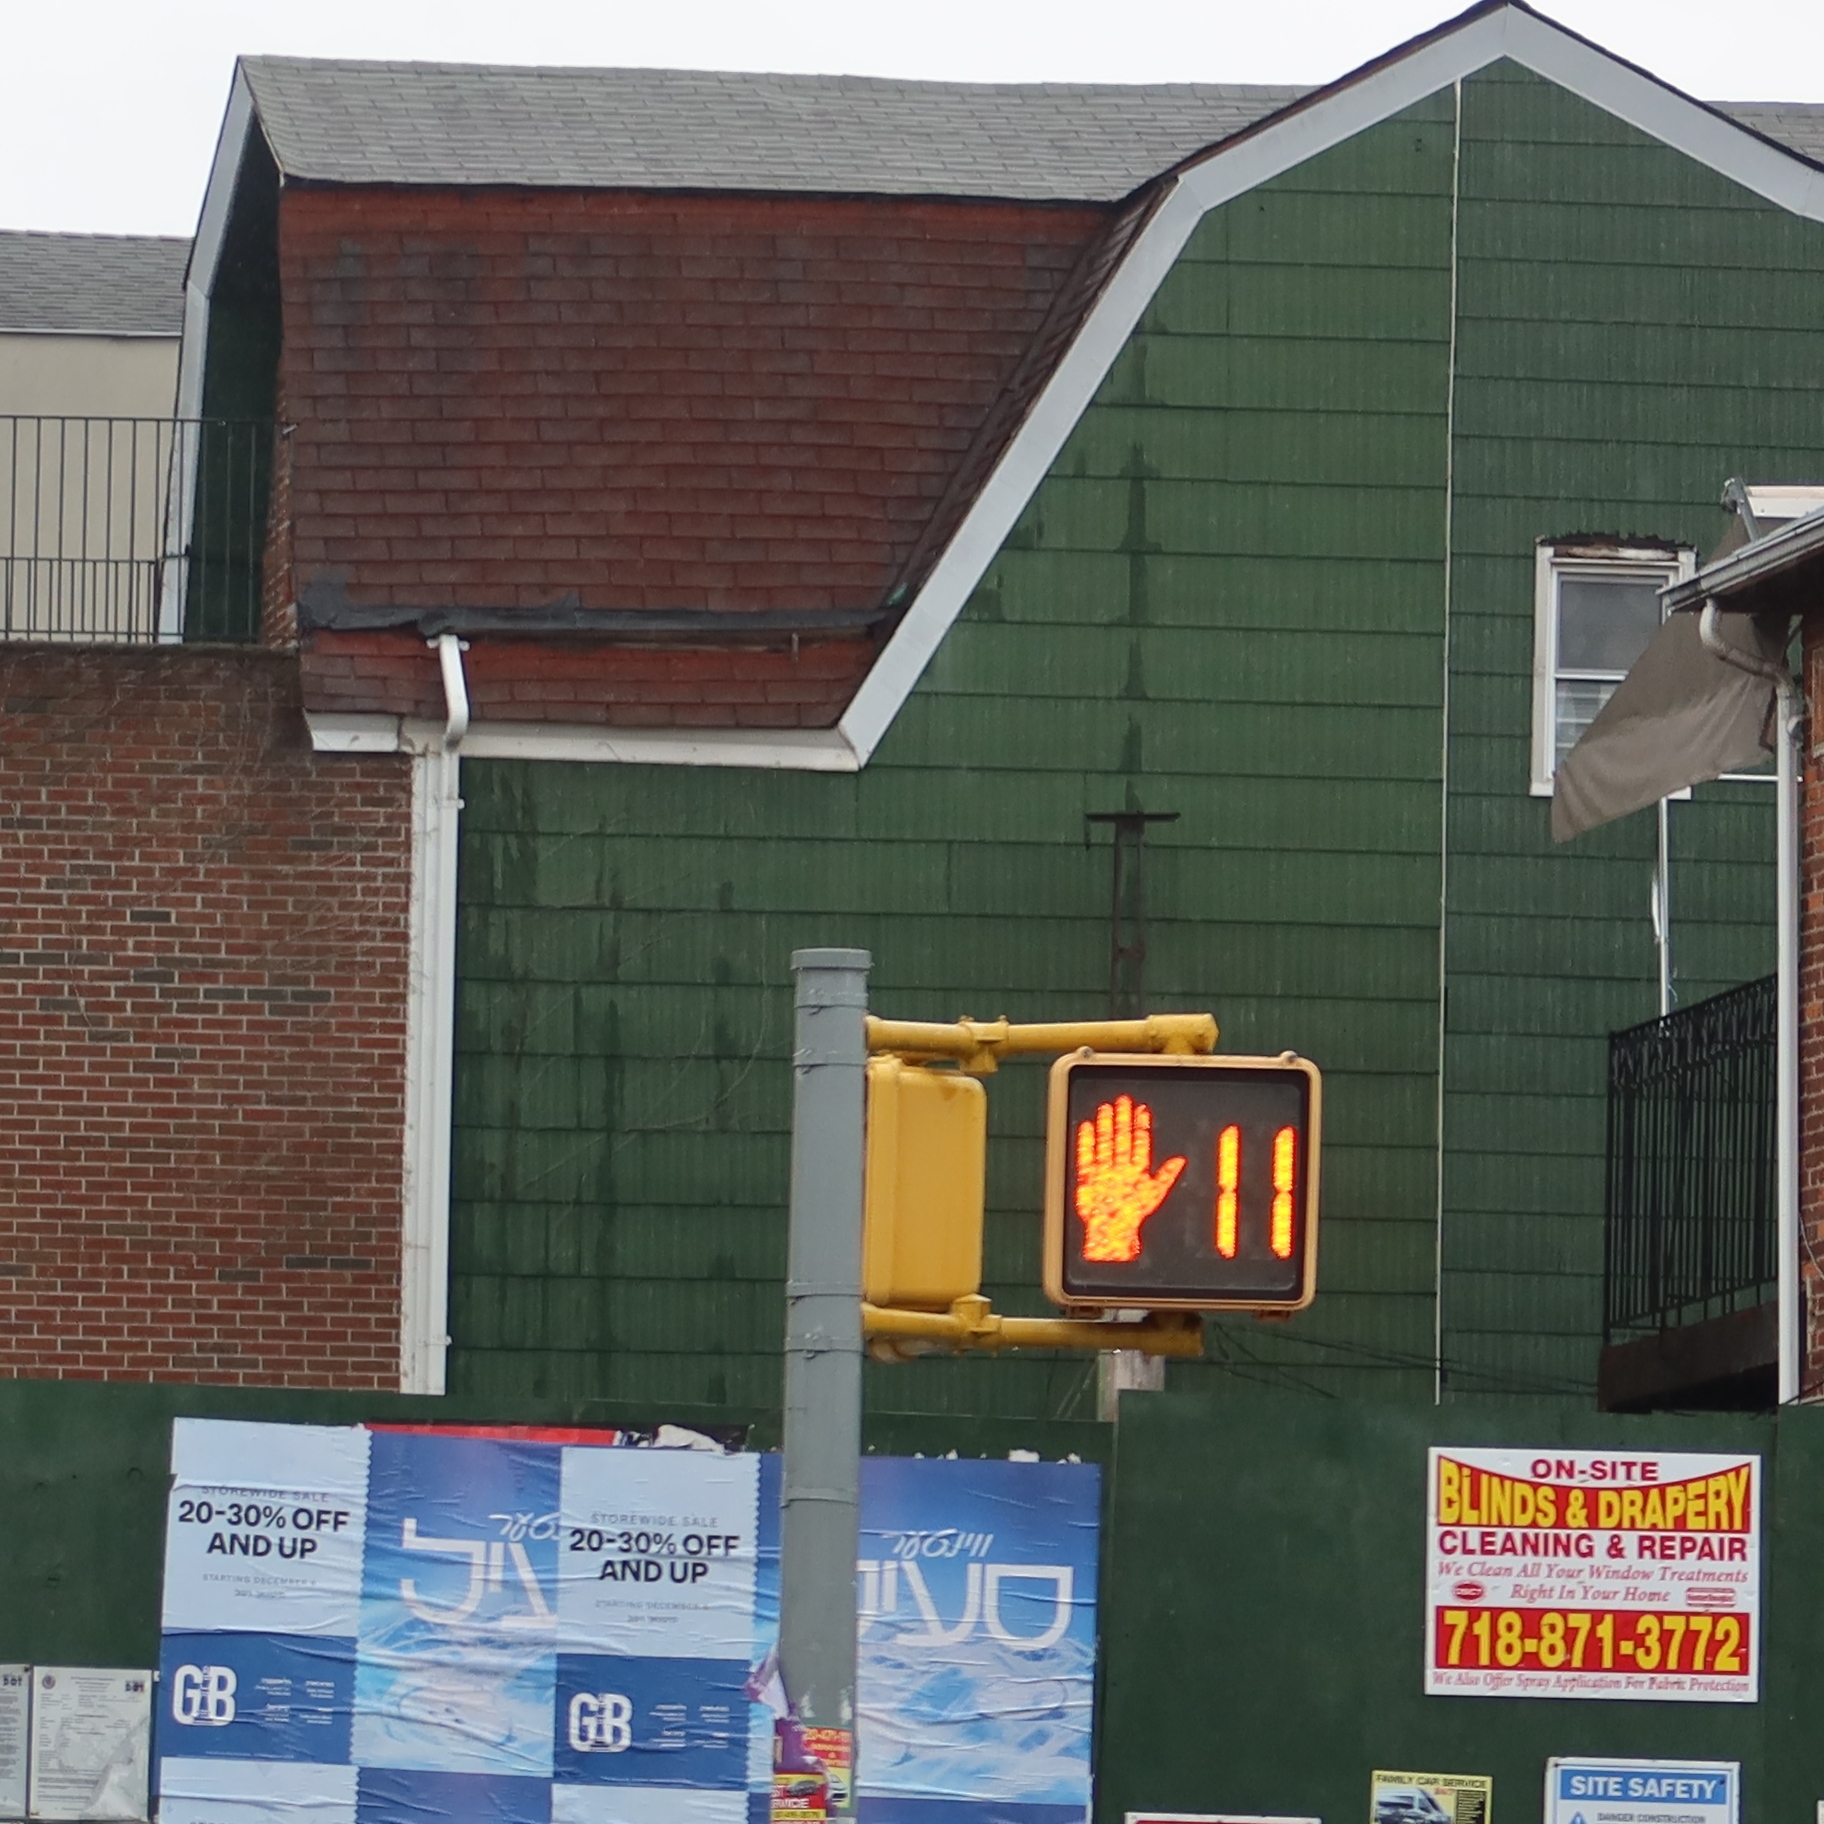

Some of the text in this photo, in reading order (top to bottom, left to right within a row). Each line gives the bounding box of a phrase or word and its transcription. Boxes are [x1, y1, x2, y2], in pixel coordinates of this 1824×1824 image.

[1215, 1124, 1296, 1260] 11
[1531, 1458, 1659, 1482] ON-SITE
[202, 1486, 330, 1503] STOREWIDE SALE
[1439, 1457, 1750, 1531] BLINDS & DRAPERY
[178, 1500, 350, 1532] 20-30% OFF
[591, 1513, 720, 1529] STOREWIDE SALE
[207, 1532, 318, 1559] AND UP
[568, 1528, 741, 1557] 20-30% OFF
[1438, 1530, 1748, 1562] CLEANING & REPAIR
[599, 1559, 710, 1584] AND UP
[1438, 1561, 1749, 1583] We Clean All Your Window Treatments
[1510, 1584, 1556, 1604] Right
[1559, 1585, 1576, 1600] In
[1580, 1586, 1621, 1602] Your
[1624, 1587, 1670, 1602] Home
[1443, 1609, 1741, 1672] 718-871-3772
[173, 1664, 238, 1727] GB
[1432, 1672, 1452, 1686] We
[1482, 1673, 1513, 1691] Offer
[1516, 1674, 1550, 1692] Spray
[1553, 1675, 1622, 1692] Application
[1624, 1677, 1645, 1690] For
[1689, 1678, 1750, 1693] Protection
[568, 1692, 633, 1754] GB
[1569, 1775, 1717, 1800] SITE SAFETY
